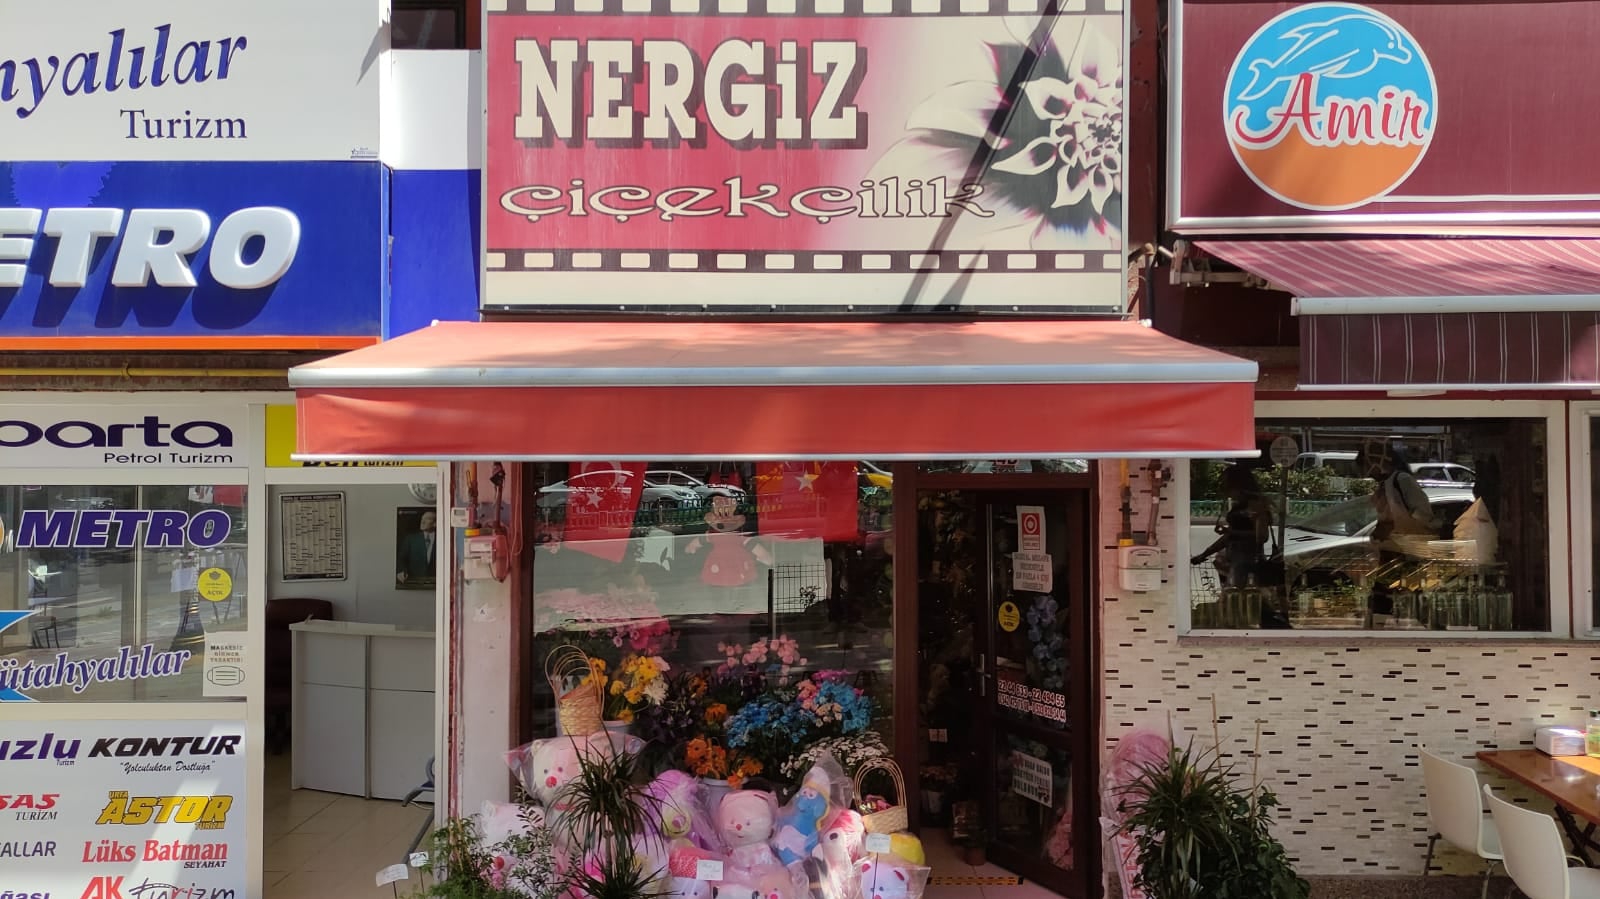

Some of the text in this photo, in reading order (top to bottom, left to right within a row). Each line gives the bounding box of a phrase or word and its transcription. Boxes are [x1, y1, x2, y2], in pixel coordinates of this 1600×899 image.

[1234, 72, 1425, 144] Amir
[120, 108, 248, 139] Turizm
[104, 452, 233, 464] Petrol Turizm
[15, 509, 231, 548] METRO
[88, 735, 241, 758] KONTUR
[81, 839, 228, 863] Lüks Batman
[183, 861, 227, 869] SEYAHAT
